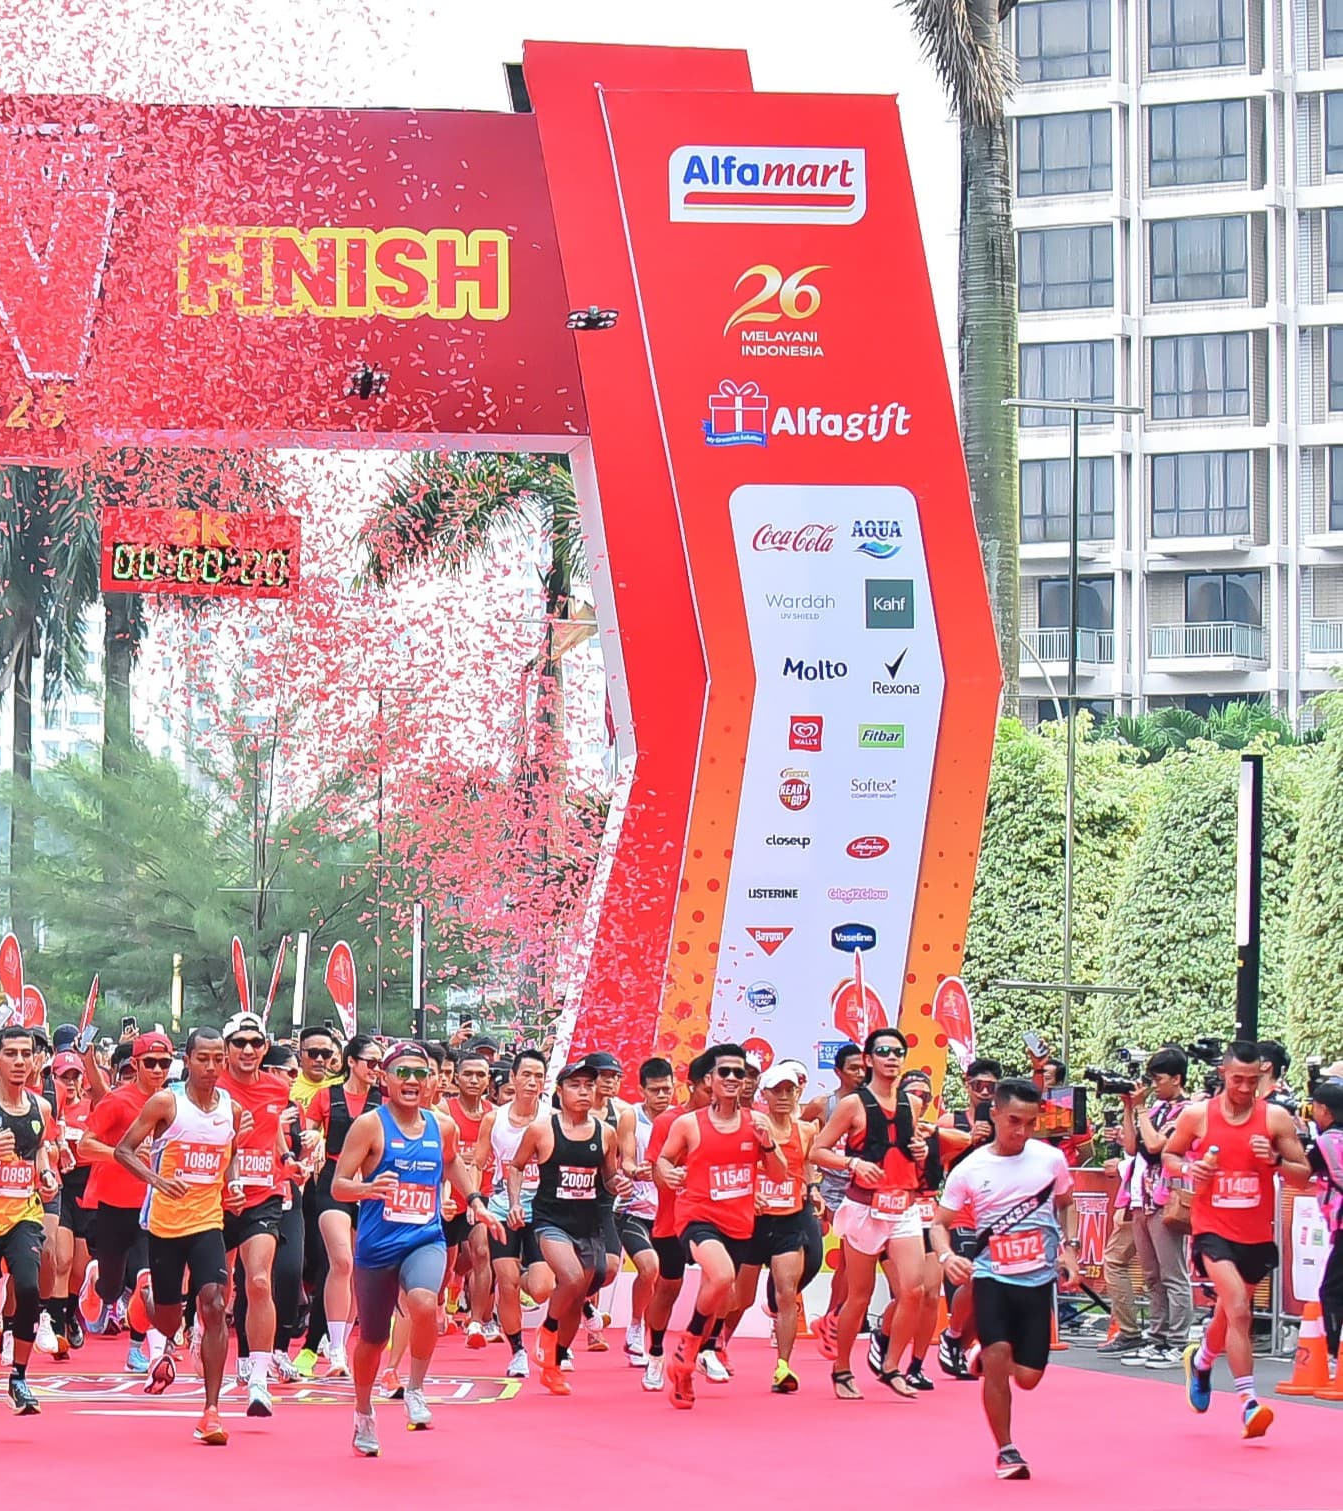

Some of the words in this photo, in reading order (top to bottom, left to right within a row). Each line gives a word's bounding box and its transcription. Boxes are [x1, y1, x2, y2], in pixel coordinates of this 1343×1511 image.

[683, 155, 855, 187] Alfamart
[178, 225, 511, 321] FINISH
[723, 264, 833, 338] 26
[741, 331, 818, 342] MELAYANI
[741, 346, 824, 357] INDONESIA
[771, 402, 911, 442] Alfagift
[850, 520, 903, 541] AQUA
[765, 593, 836, 609] Wardah
[872, 596, 906, 612] Kahf
[783, 657, 848, 681] Molto
[872, 682, 920, 695] Rexona
[861, 729, 901, 743] Fitbar
[779, 784, 808, 796] READY
[851, 778, 893, 792] Softex
[766, 834, 810, 849] closeup
[748, 888, 799, 899] LISTERINE
[828, 888, 888, 901] Glad2Glow
[834, 932, 874, 942] Vaseline
[184, 1151, 222, 1169] 10884
[238, 1154, 272, 1172] 12085
[392, 1189, 431, 1209] 12170
[996, 1236, 1037, 1259] 11572
